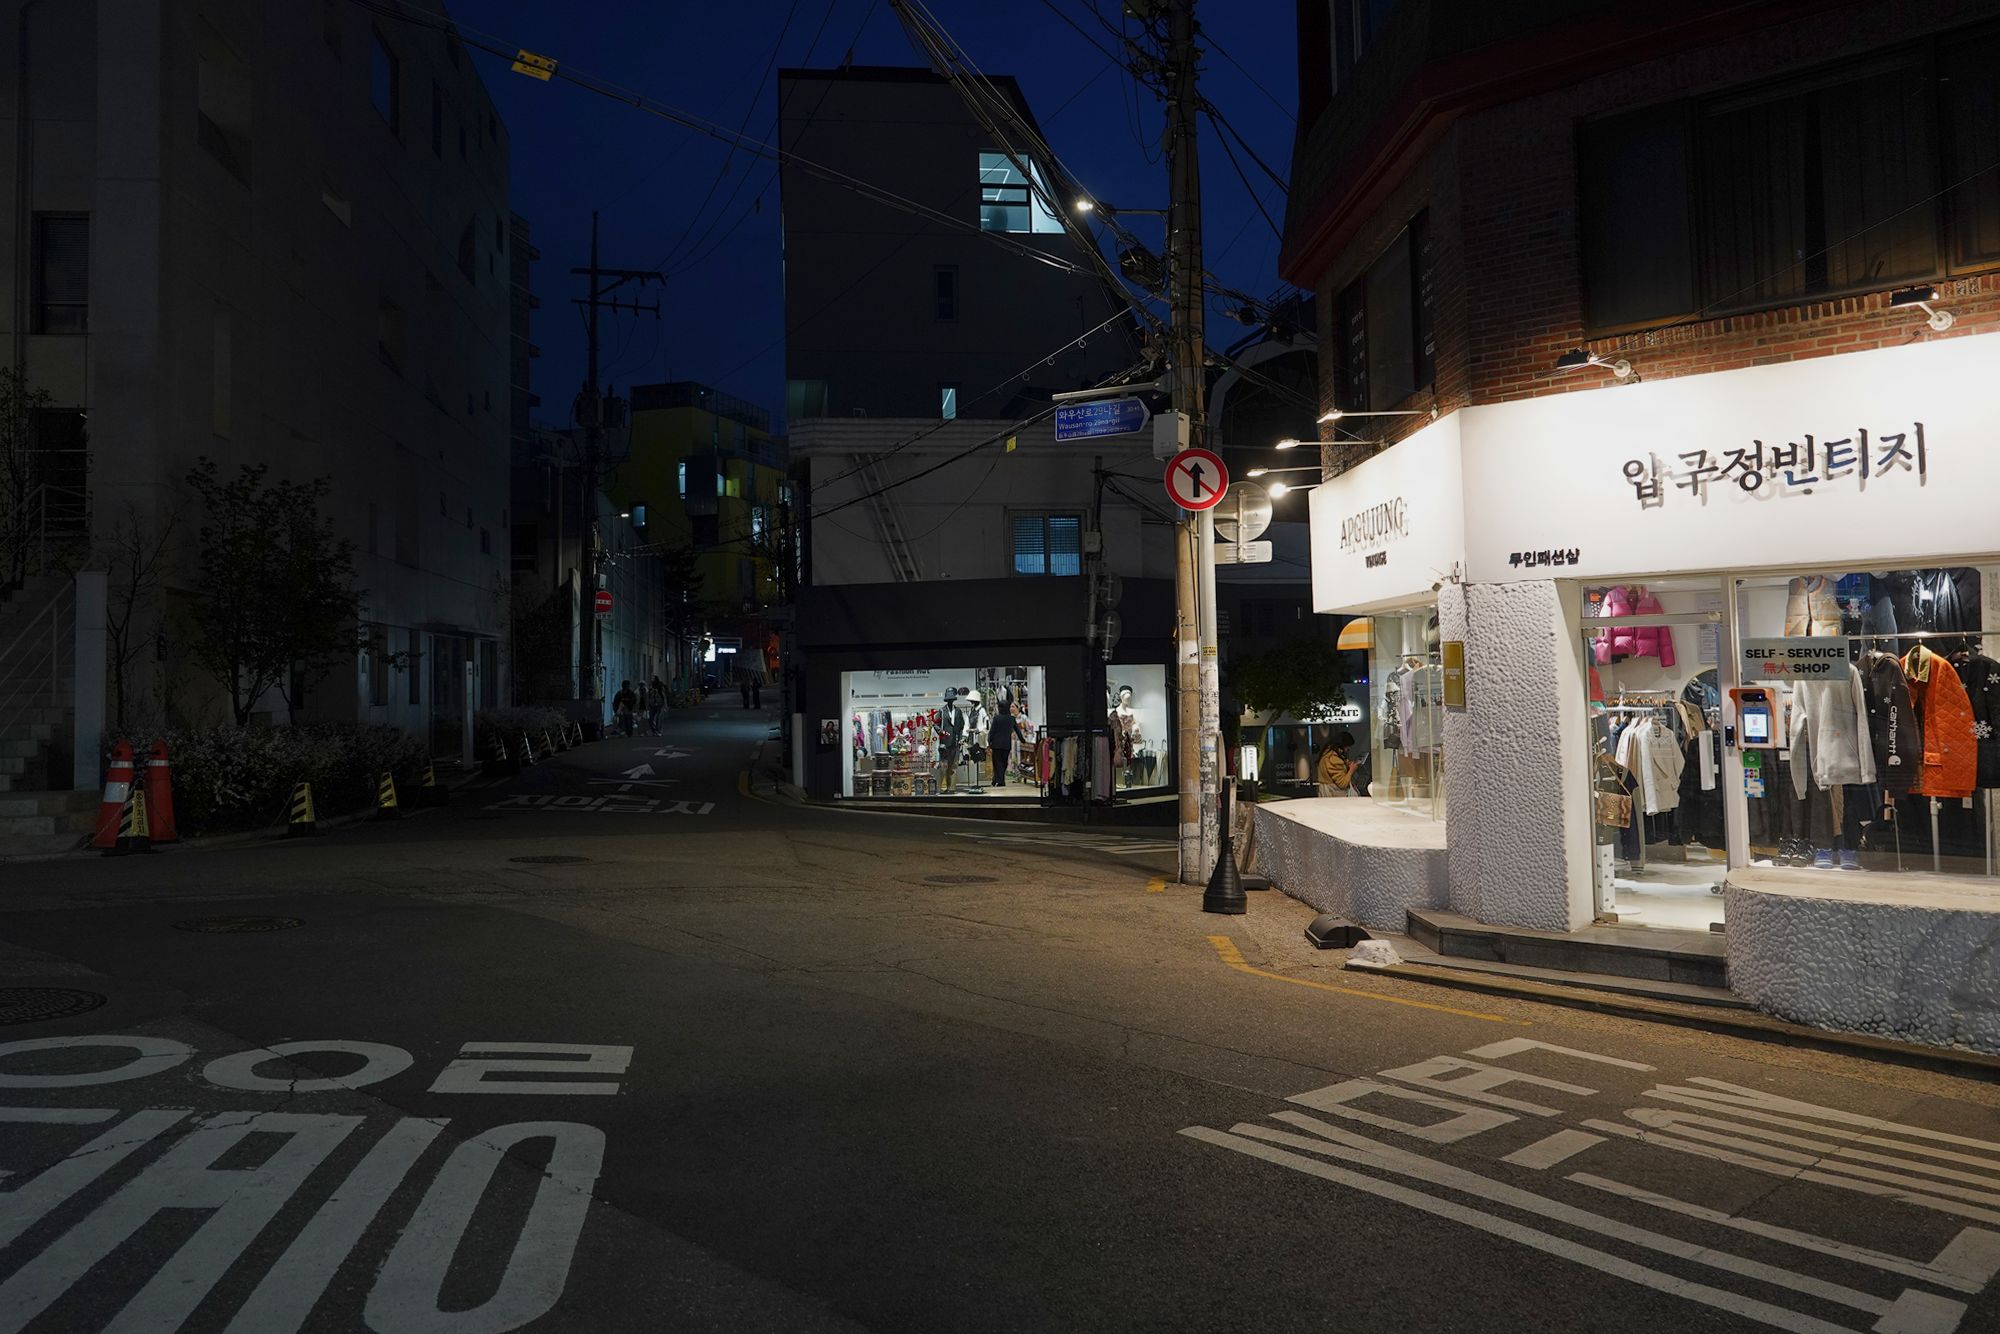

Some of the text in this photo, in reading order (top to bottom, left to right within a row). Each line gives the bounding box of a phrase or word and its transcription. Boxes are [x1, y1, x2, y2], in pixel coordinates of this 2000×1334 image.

[1058, 404, 1120, 420] 와우산로29나길
[1058, 420, 1093, 430] Wausan-ro
[1622, 422, 1928, 501] 압구정빈티지
[1340, 496, 1404, 549] APGUJUNG
[1745, 648, 1776, 658] SELF
[1787, 647, 1845, 658] SERVICE
[1763, 662, 1831, 674] 無人 SHOP
[1888, 705, 1898, 754] carhartt
